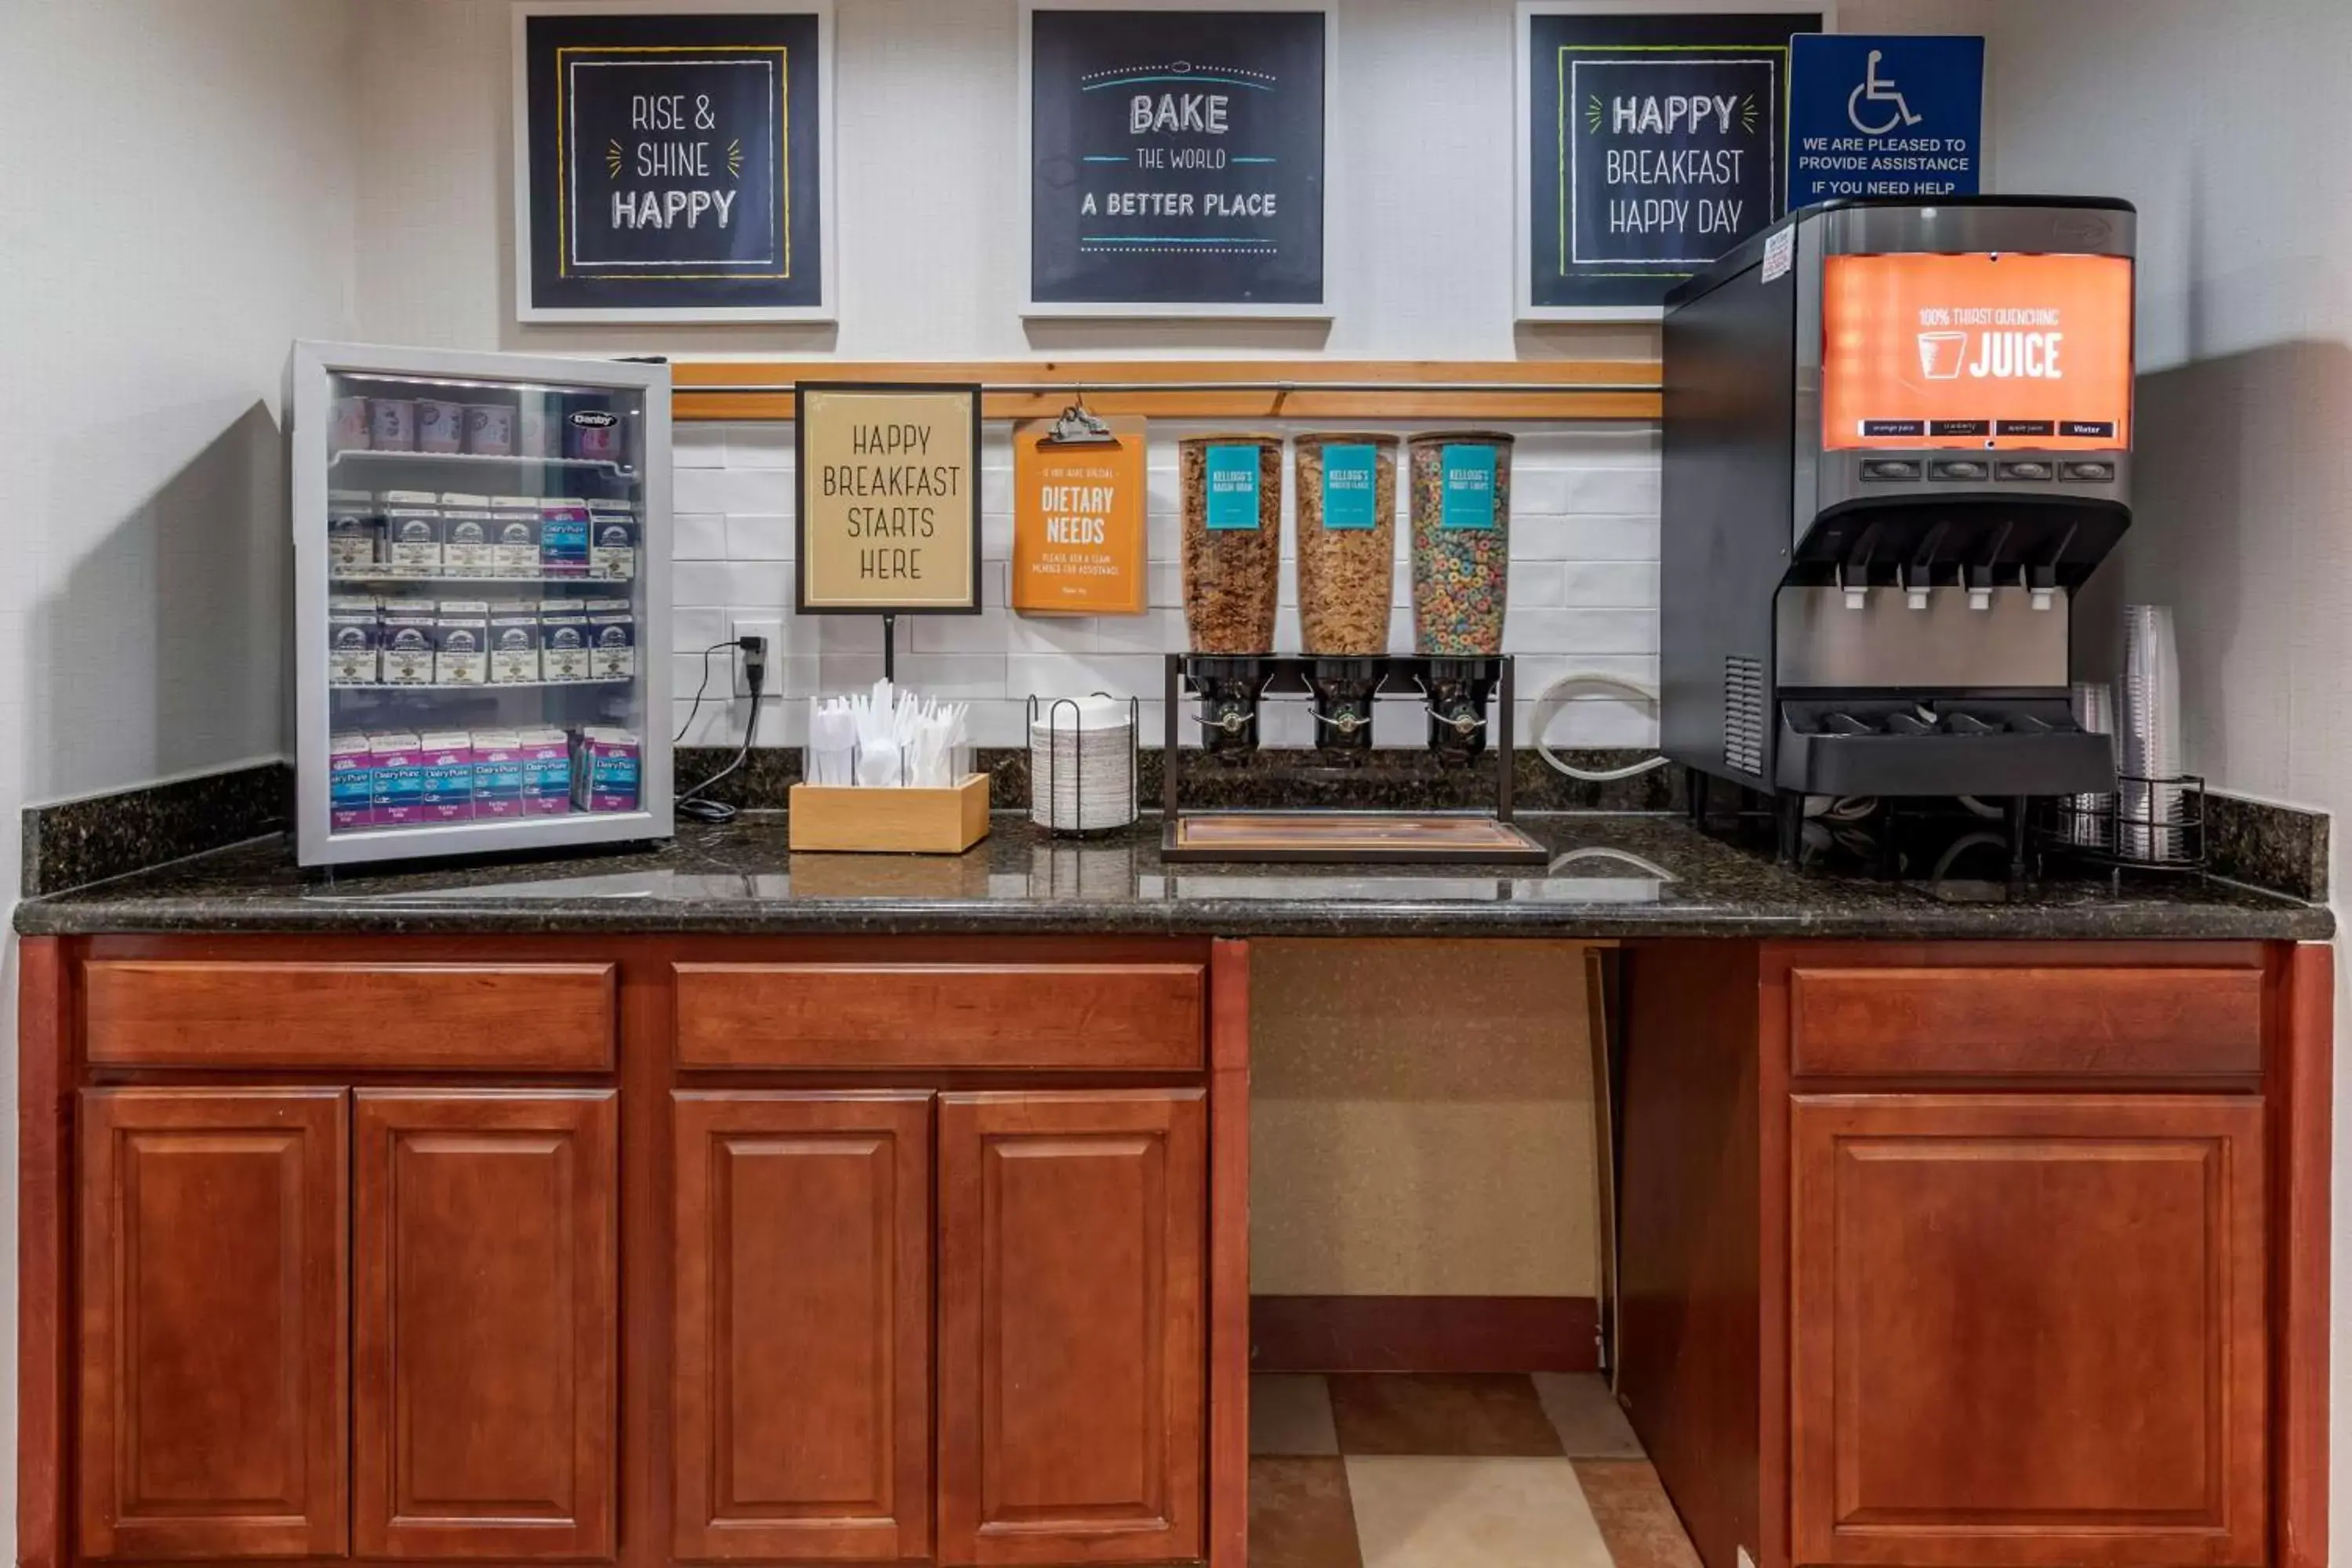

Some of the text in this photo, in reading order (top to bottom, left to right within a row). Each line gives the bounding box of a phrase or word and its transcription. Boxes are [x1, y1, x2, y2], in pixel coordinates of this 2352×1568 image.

[632, 94, 716, 130] RISE &
[1130, 93, 1229, 134] BAKE
[1613, 96, 1737, 134] HAPPY
[637, 142, 710, 177] SHINE
[1137, 148, 1225, 169] THE WORLD
[1803, 138, 1965, 151] WE ARE PLEASED TO
[1607, 150, 1744, 184] BREAKFAST
[1799, 157, 1969, 170] PROVIDE ASSISTANCE
[1812, 181, 1955, 194] IF YOU NEED HELP
[612, 190, 736, 229] HAPPY
[1081, 192, 1277, 216] A BETTER PLACE
[1610, 199, 1743, 234] HAPPY DAY
[1919, 307, 2060, 326] 100% THIRST QUENCHING
[1969, 331, 2063, 379] JUICE
[575, 415, 612, 426] Danby
[2073, 424, 2100, 434] Water
[852, 424, 931, 456] HAPPY
[824, 466, 960, 496] BREAKFAST
[1042, 486, 1114, 514] DIETARY
[848, 507, 934, 537] STARTS
[1047, 517, 1105, 544] NEEDS
[861, 549, 922, 579] HERE
